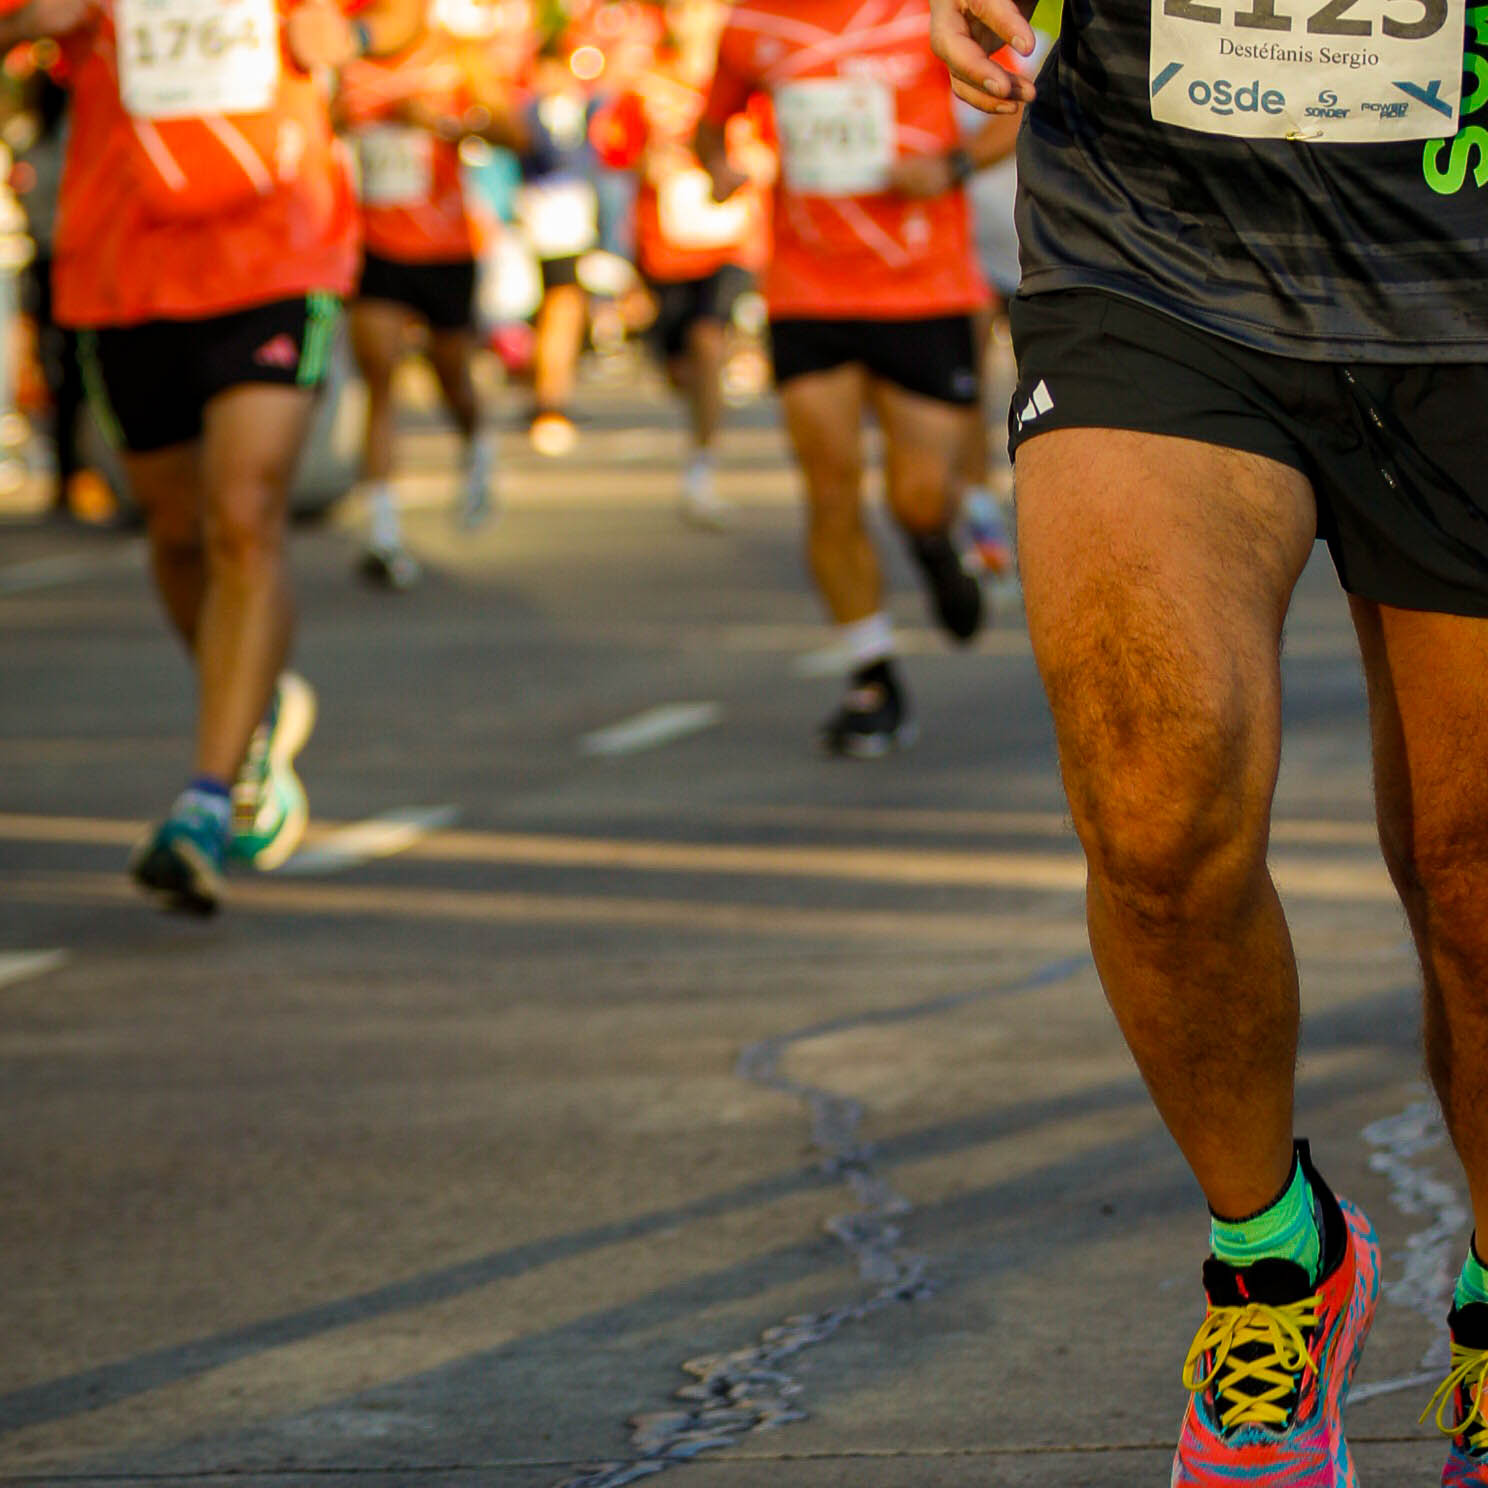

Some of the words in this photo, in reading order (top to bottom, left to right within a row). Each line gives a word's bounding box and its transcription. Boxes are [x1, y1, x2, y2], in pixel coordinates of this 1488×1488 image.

[1219, 37, 1313, 63] Destéfanis
[1319, 46, 1379, 69] Sergio
[1188, 79, 1286, 115] osde
